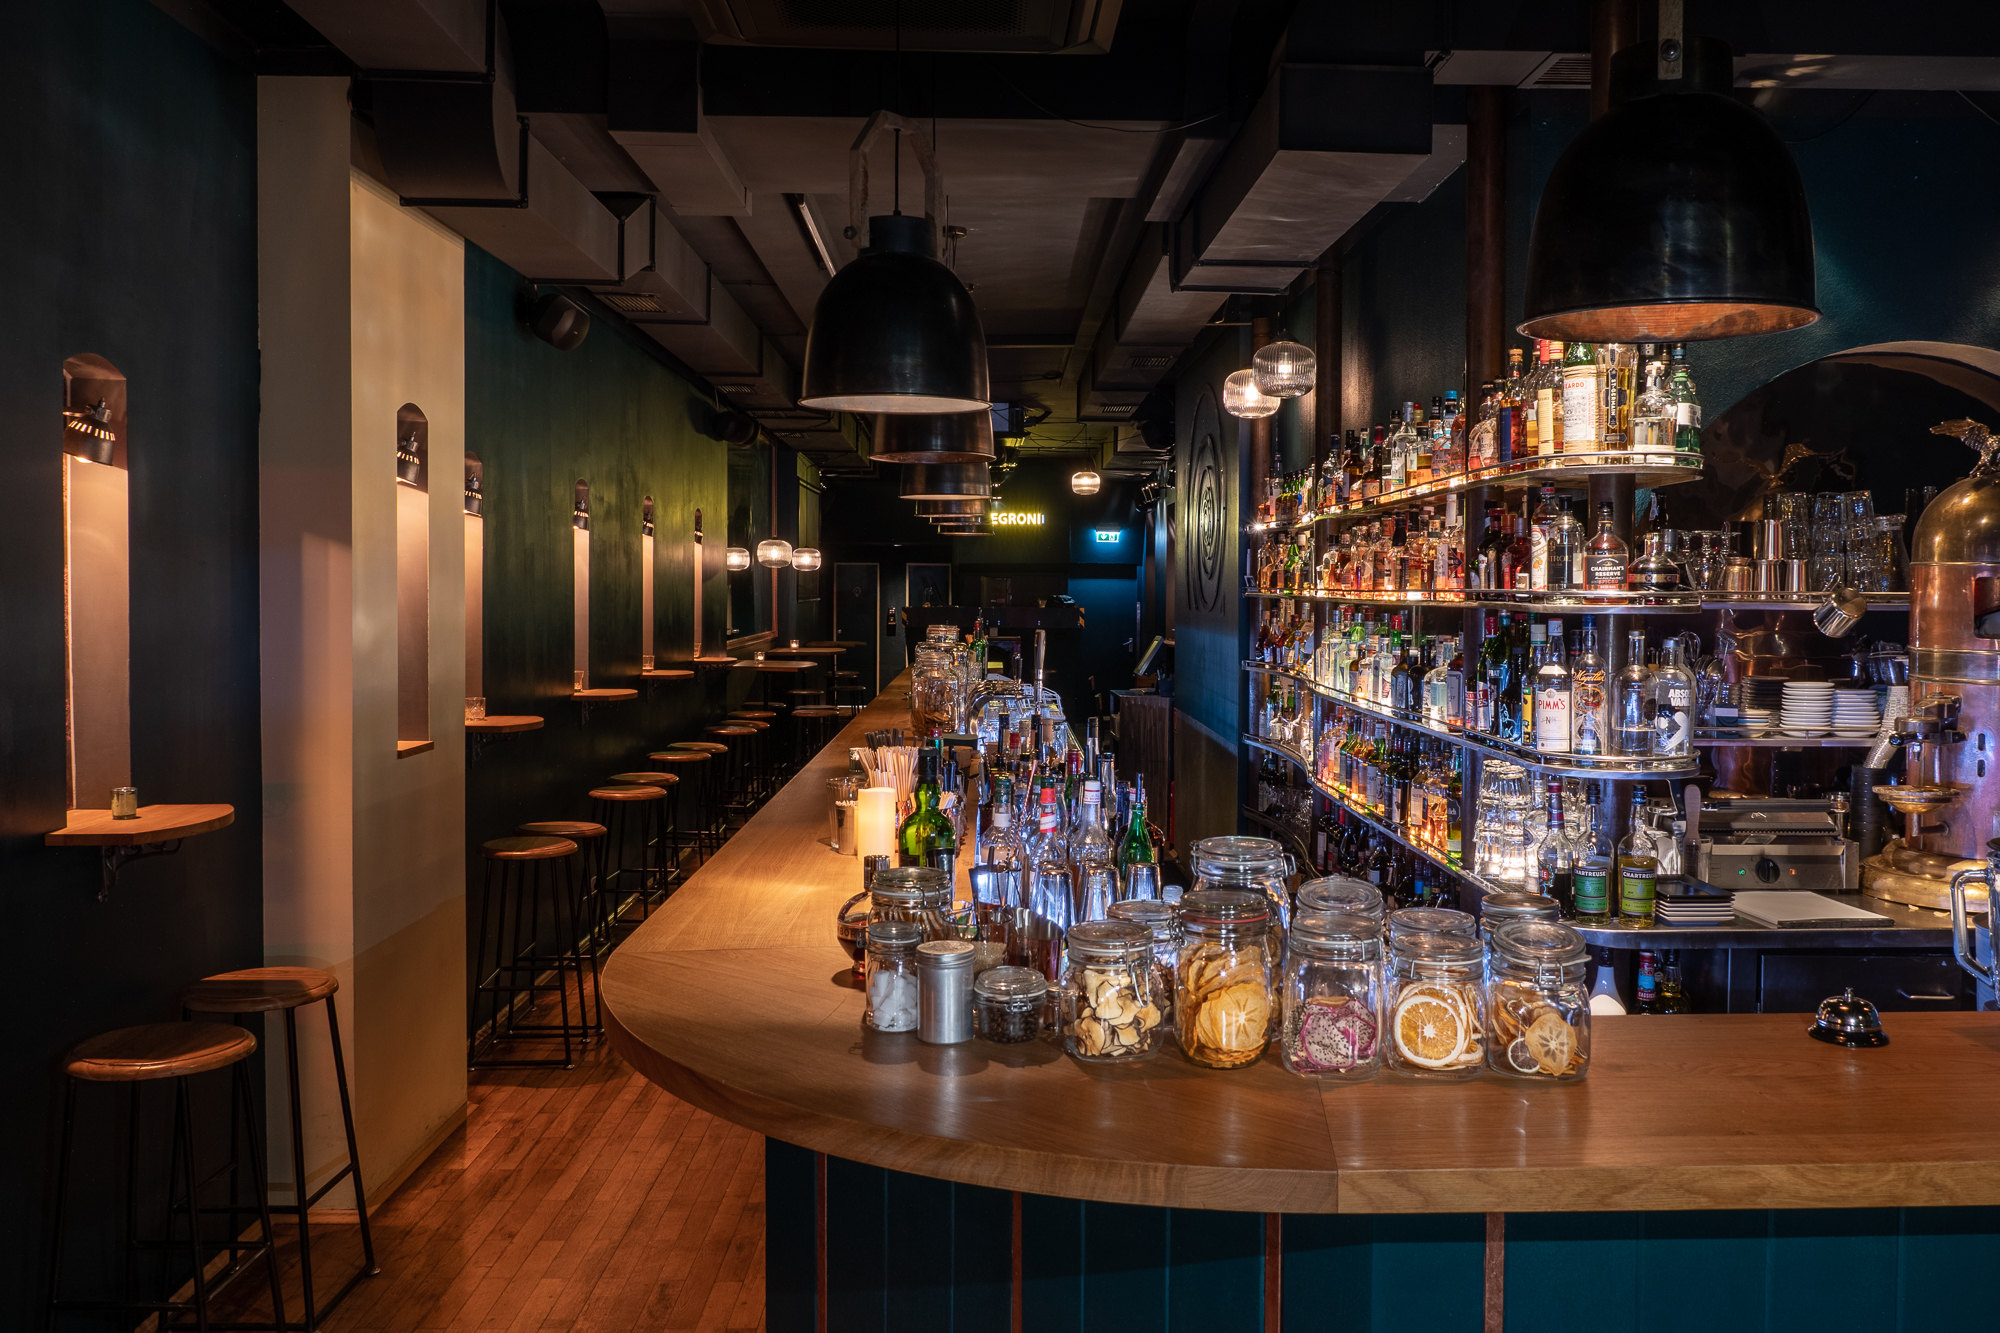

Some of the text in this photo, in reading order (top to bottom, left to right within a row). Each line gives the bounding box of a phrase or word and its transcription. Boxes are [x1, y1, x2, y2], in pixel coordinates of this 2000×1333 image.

[991, 512, 1042, 525] EGRONI
[1538, 698, 1566, 710] PIMM'S
[1574, 868, 1606, 877] CHARTREUSE
[1623, 871, 1655, 879] CHARTREU
